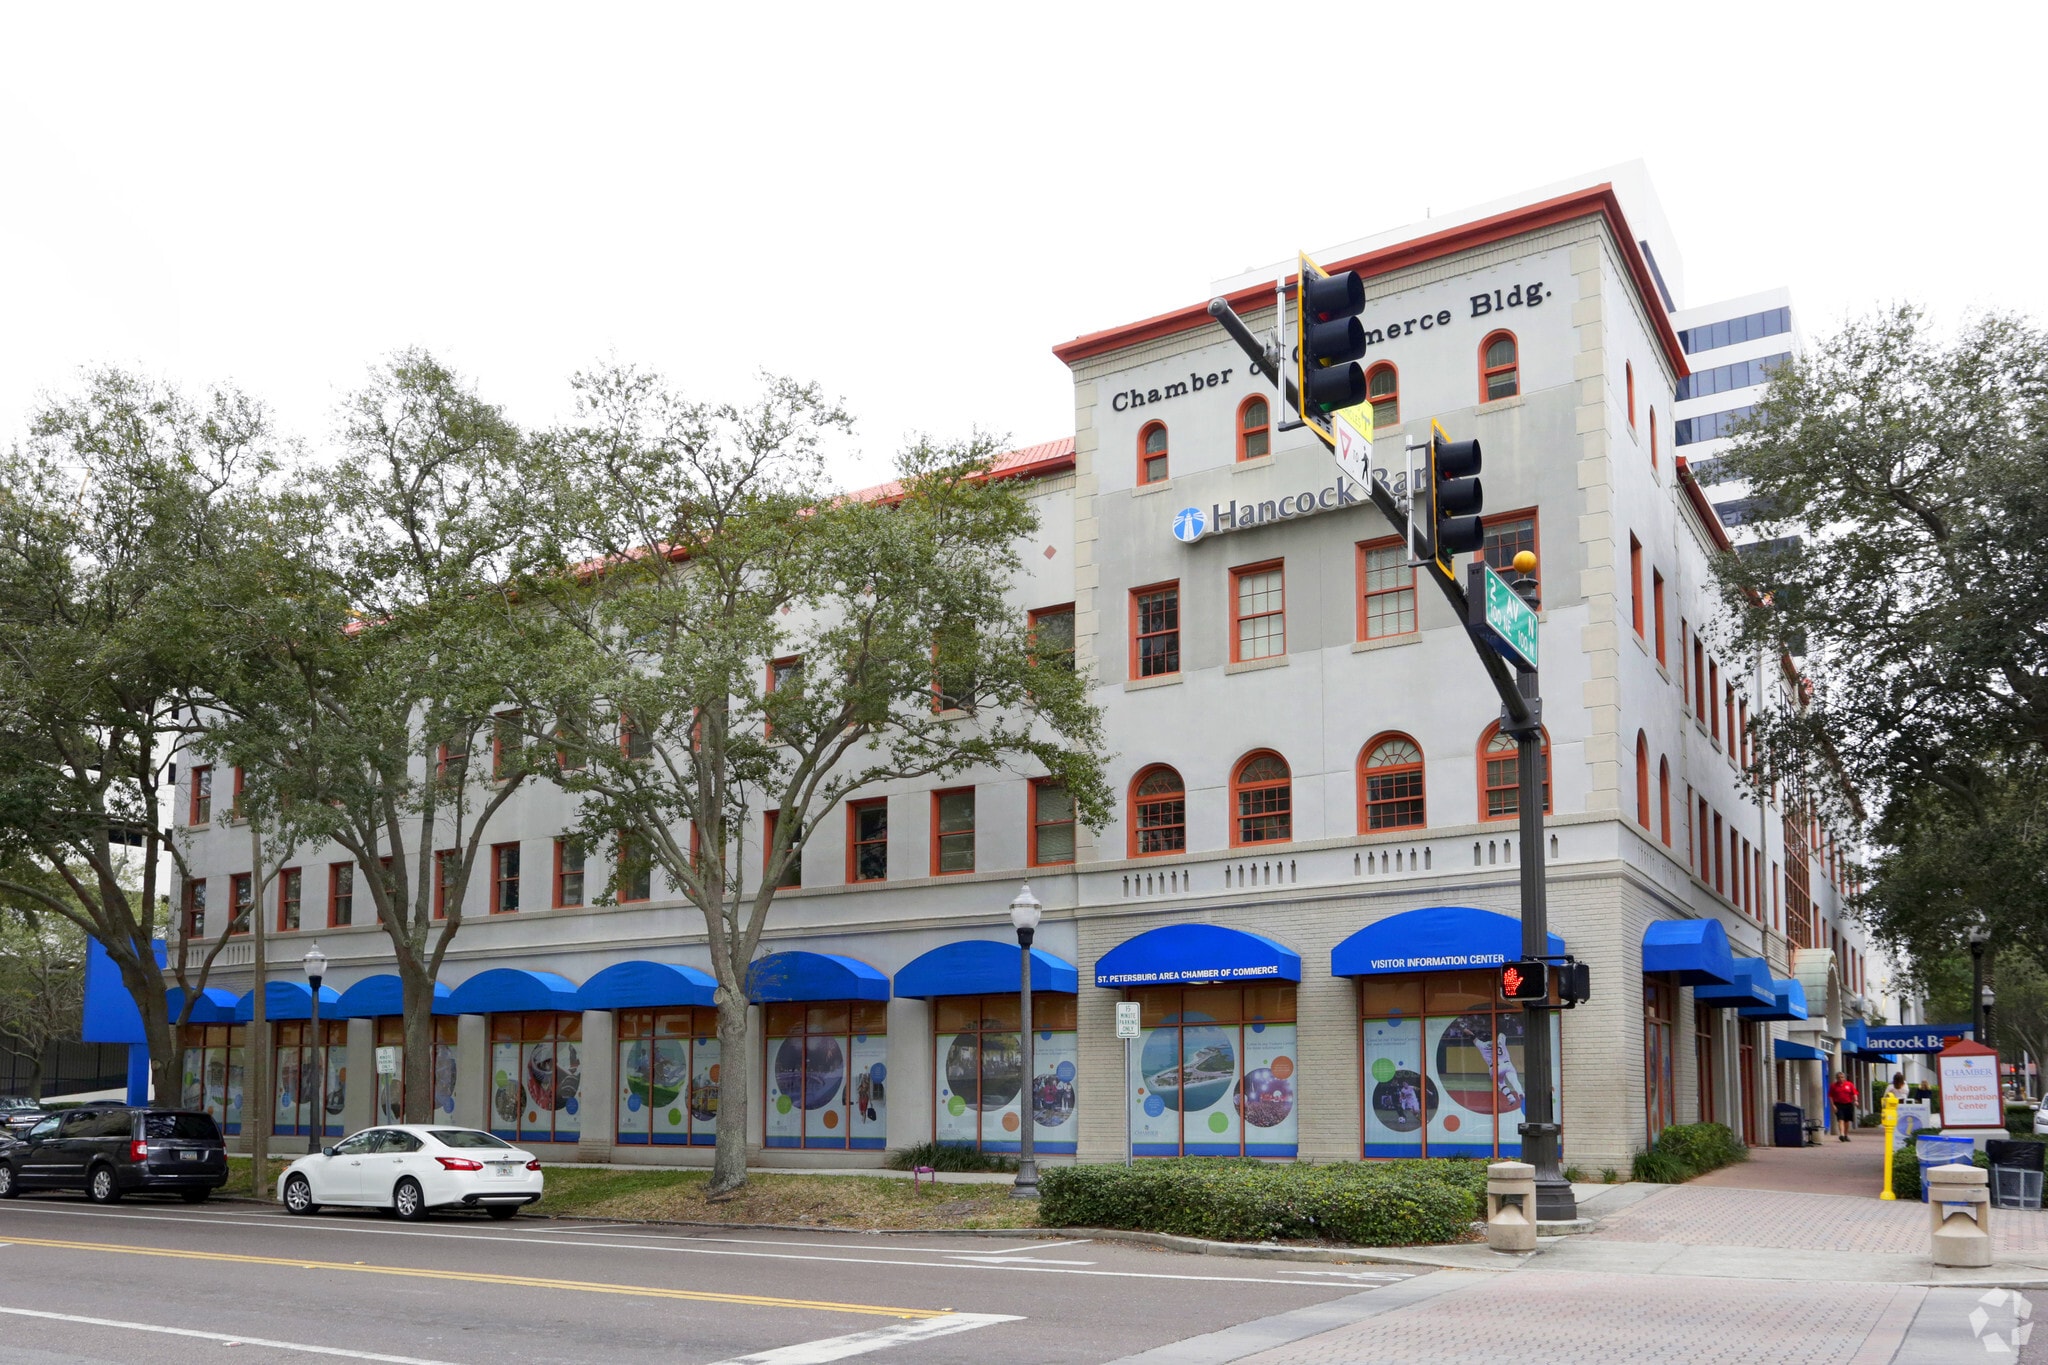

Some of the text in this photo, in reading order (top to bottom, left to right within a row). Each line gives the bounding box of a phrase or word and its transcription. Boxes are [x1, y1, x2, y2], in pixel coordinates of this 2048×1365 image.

[1112, 368, 1233, 412] Chamber
[1469, 281, 1552, 319] Bldg.
[1212, 467, 1427, 532] Hancock Ban
[1489, 578, 1535, 640] 2 AV N
[1371, 954, 1505, 969] VISITOR INFORMATION CENTER
[1097, 965, 1278, 984] ST. PETERSBURG AREA CHAMBER OF COMMERCE
[1927, 1035, 1945, 1048] Ba
[1944, 1068, 1993, 1077] CHAMBER
[1954, 1084, 1987, 1092] Visitors
[1944, 1093, 1999, 1101] Information
[1958, 1102, 1988, 1110] Center
